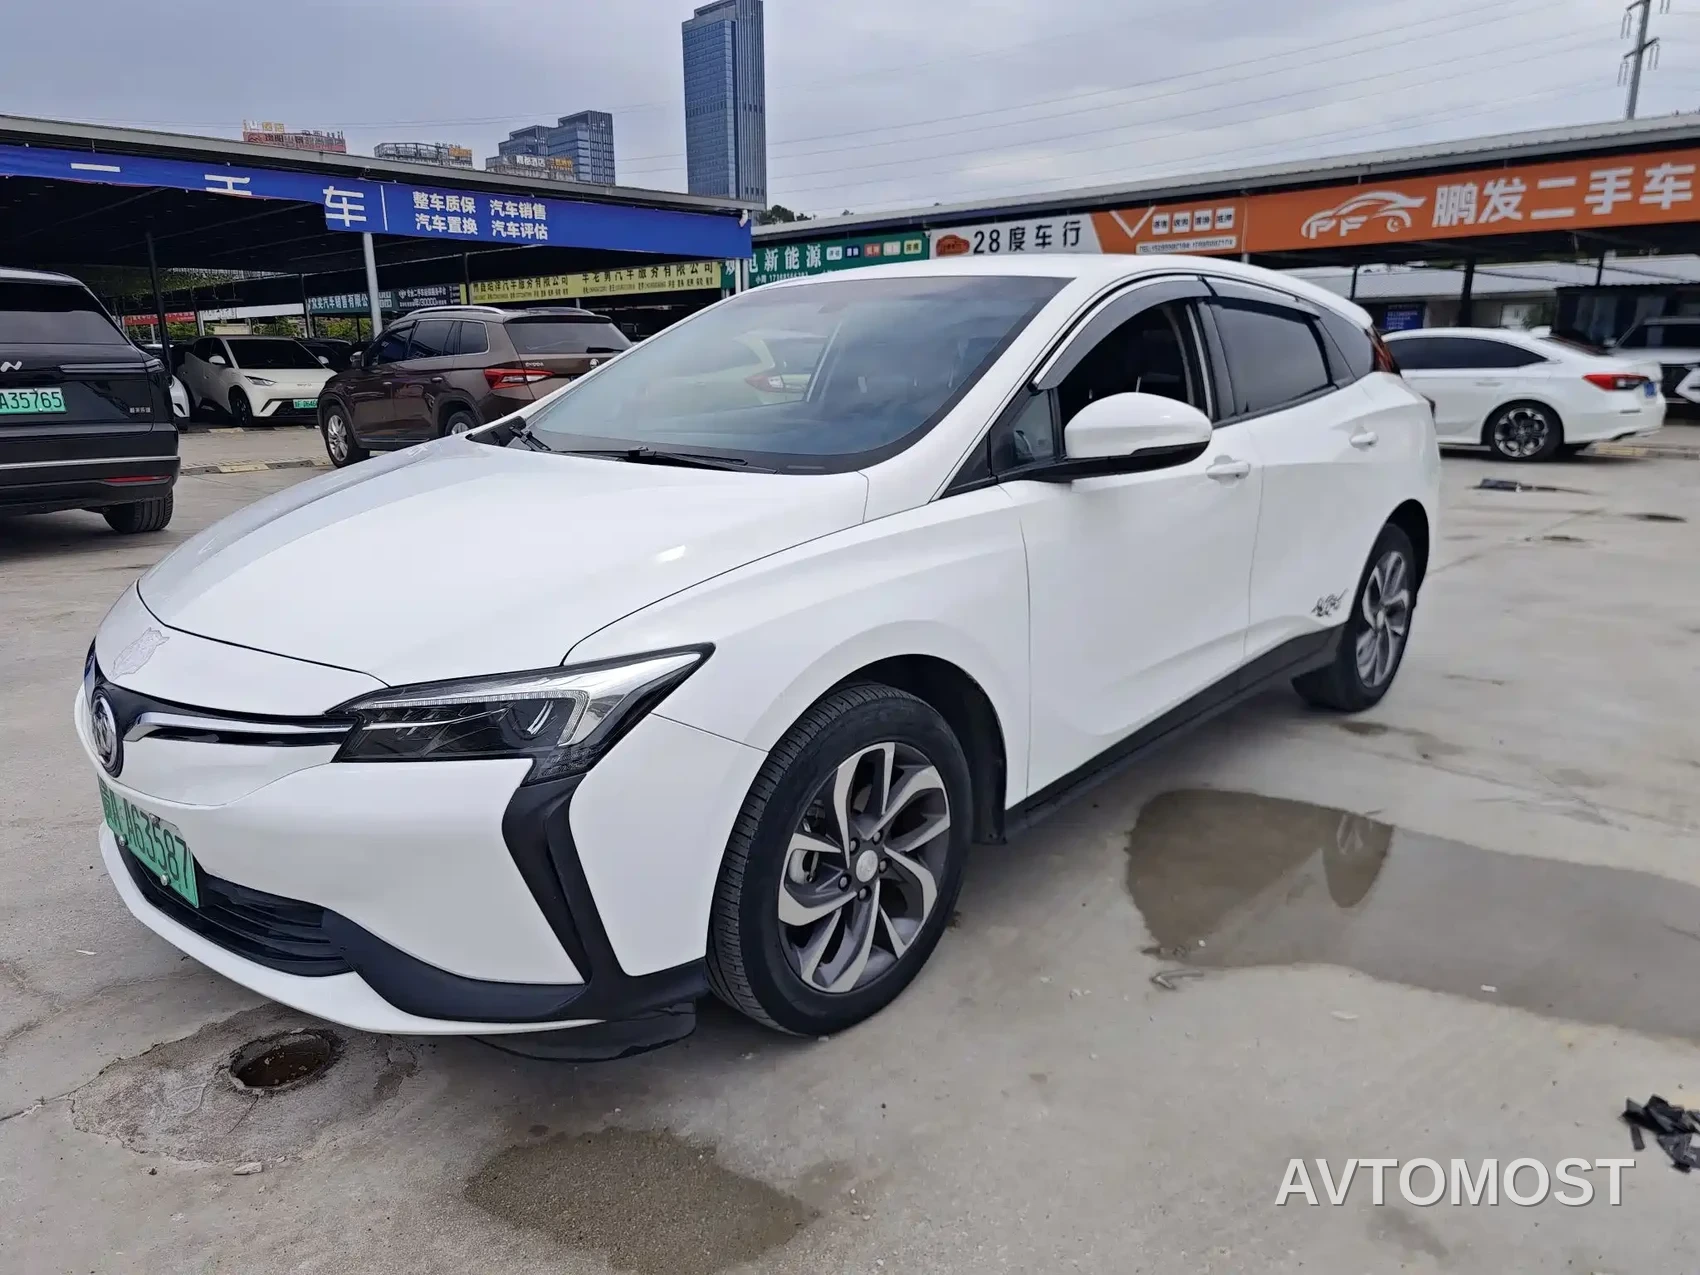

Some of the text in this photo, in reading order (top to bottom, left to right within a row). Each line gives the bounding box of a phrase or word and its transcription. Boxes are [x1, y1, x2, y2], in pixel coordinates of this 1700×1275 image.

[412, 191, 546, 220] 整车质保 汽车销售
[1432, 162, 1697, 228] 鹏发二手车
[415, 213, 548, 240] 汽车置换 汽车评估
[973, 220, 1081, 254] 28度车行
[0, 391, 62, 410] A35765
